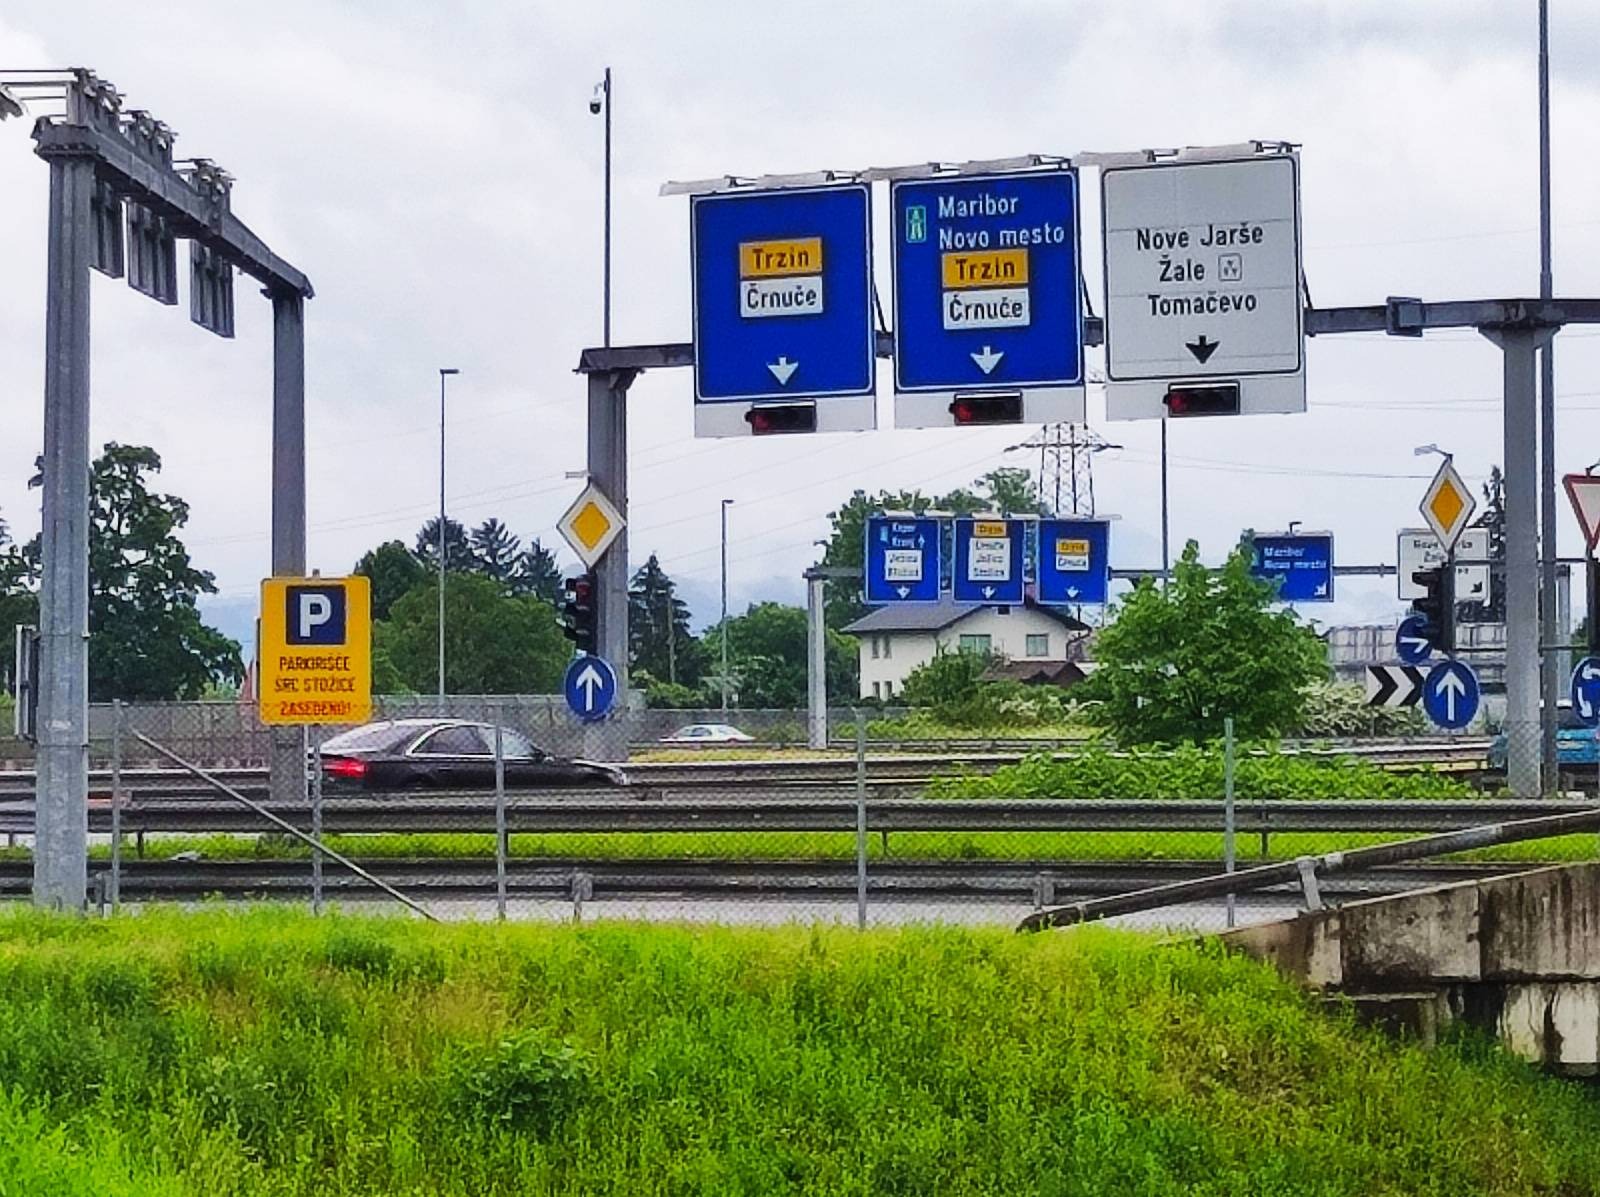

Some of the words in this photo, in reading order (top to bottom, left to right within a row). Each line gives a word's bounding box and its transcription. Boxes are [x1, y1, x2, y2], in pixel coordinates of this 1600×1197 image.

[938, 194, 1018, 219] Maribor
[939, 227, 990, 250] Novo
[1000, 222, 1065, 246] mesto
[1136, 228, 1189, 251] Nove
[1200, 222, 1263, 246] Jarše
[752, 247, 809, 270] Trzin
[955, 256, 1015, 280] Trzin
[1158, 254, 1205, 282] Žale
[746, 284, 817, 310] Črnuče
[949, 294, 1023, 321] Črnuče
[1148, 290, 1257, 316] Tomačevo
[300, 594, 331, 637] P
